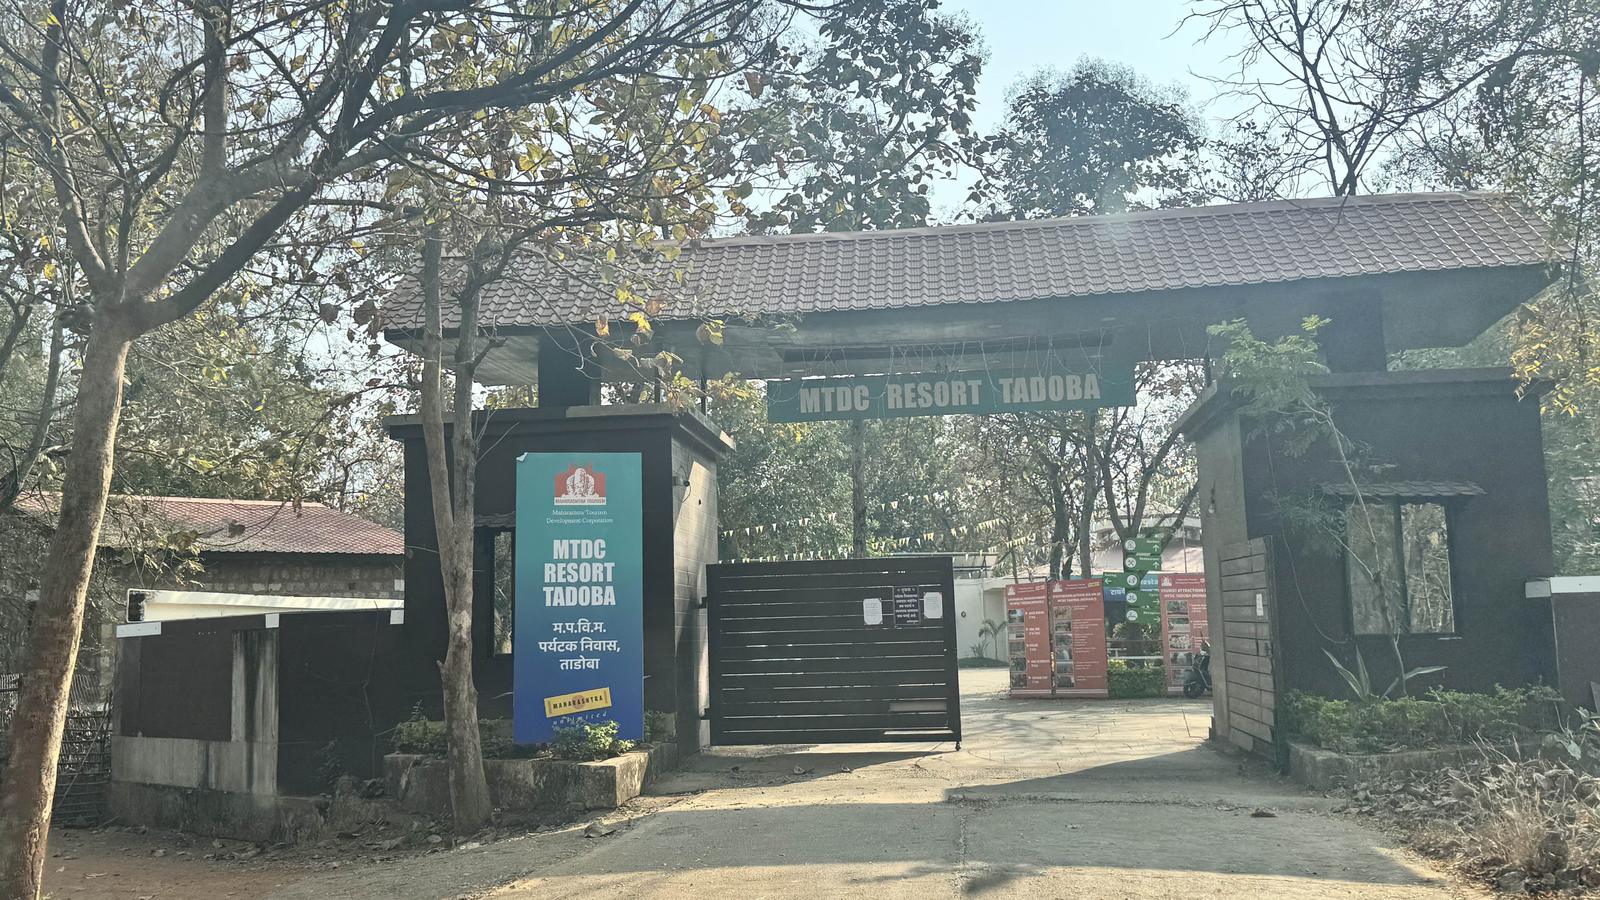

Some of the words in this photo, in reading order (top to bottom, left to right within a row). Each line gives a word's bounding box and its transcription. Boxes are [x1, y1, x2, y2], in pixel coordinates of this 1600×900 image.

[800, 384, 869, 414] MTDC
[887, 379, 982, 409] RESORT
[999, 373, 1101, 404] TADOBA
[546, 517, 581, 525] Development
[582, 517, 613, 525] Corporation
[553, 538, 606, 560] MTDC
[544, 562, 615, 583] RESORT
[542, 585, 617, 607] TADOBA
[552, 618, 607, 634] म.प.वि.म.
[538, 637, 578, 653] पर्यटक
[579, 637, 621, 653] निवास,
[559, 655, 601, 671] ताडोबा
[553, 695, 603, 709] MAHARASHTRA
